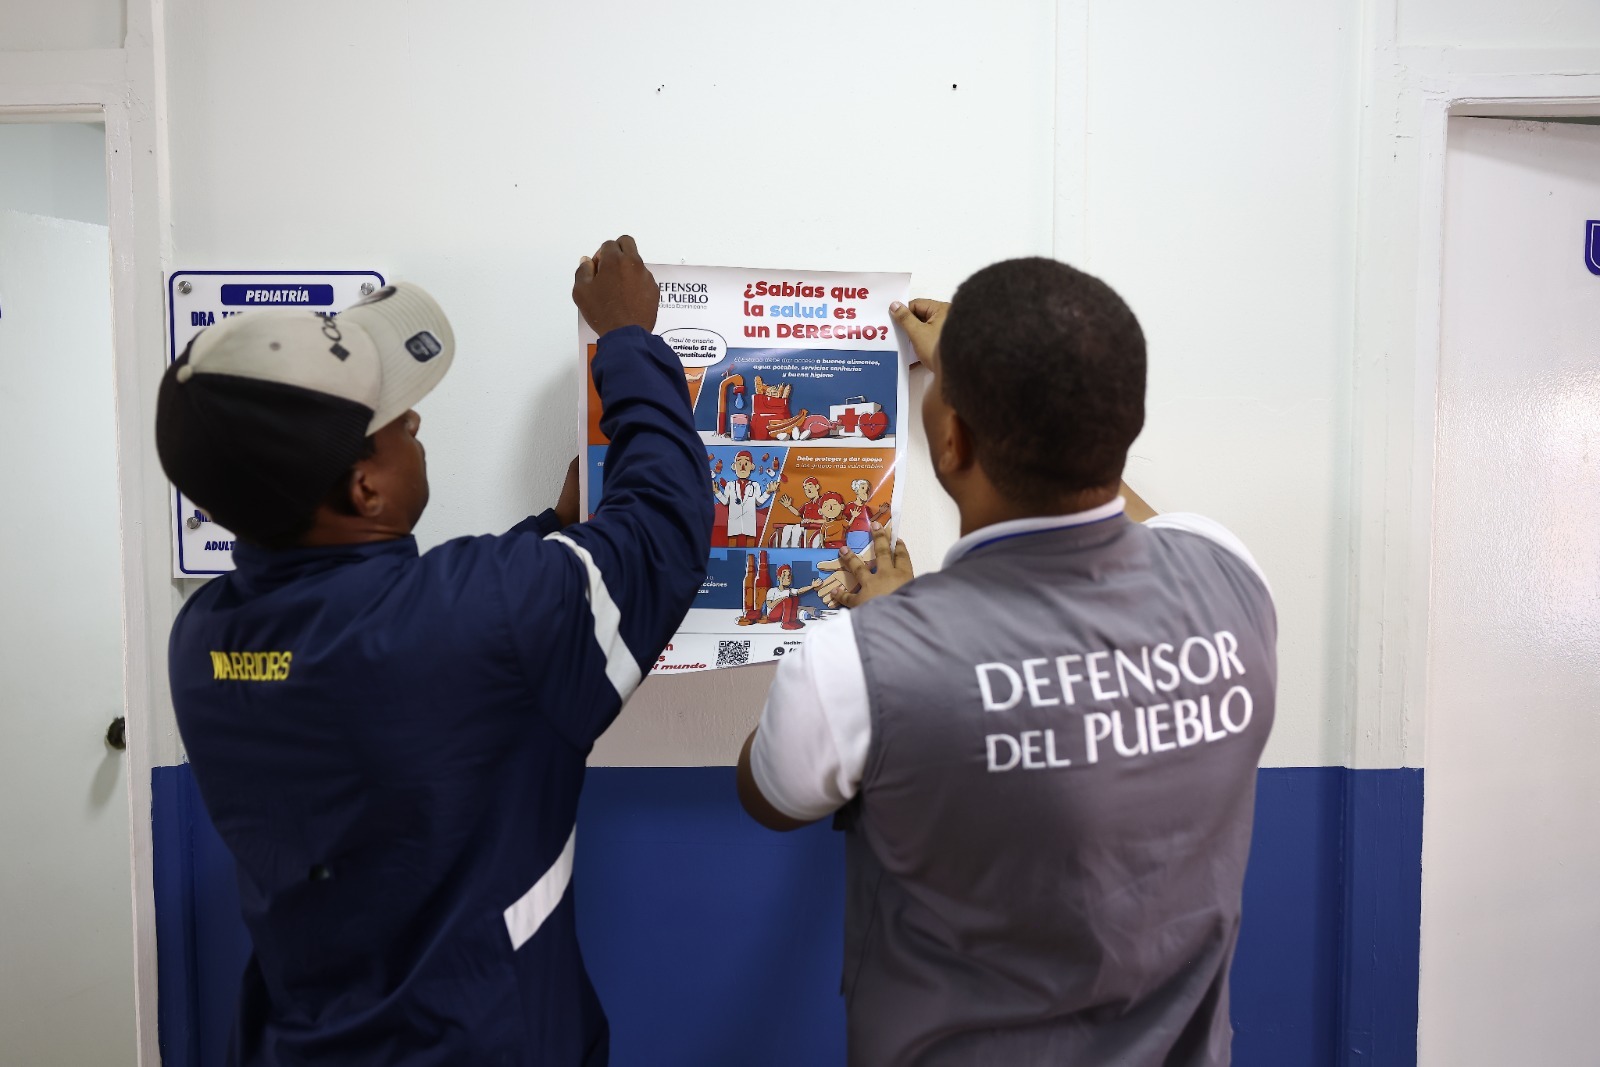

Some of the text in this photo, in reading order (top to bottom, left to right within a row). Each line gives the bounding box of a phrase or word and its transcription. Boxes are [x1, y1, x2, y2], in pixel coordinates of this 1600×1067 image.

[245, 286, 310, 303] PEDIATRÍA
[658, 282, 708, 293] EFENSOR
[743, 280, 870, 303] ¿Sabías que
[668, 293, 709, 304] PUEBLO
[743, 300, 856, 320] la salud es
[743, 323, 889, 341] un DERECHO?
[209, 650, 293, 682] WARRIORS
[660, 661, 708, 671] mundo
[974, 629, 1247, 712] DEFENSOR
[984, 684, 1255, 774] DEL PUEBLO
